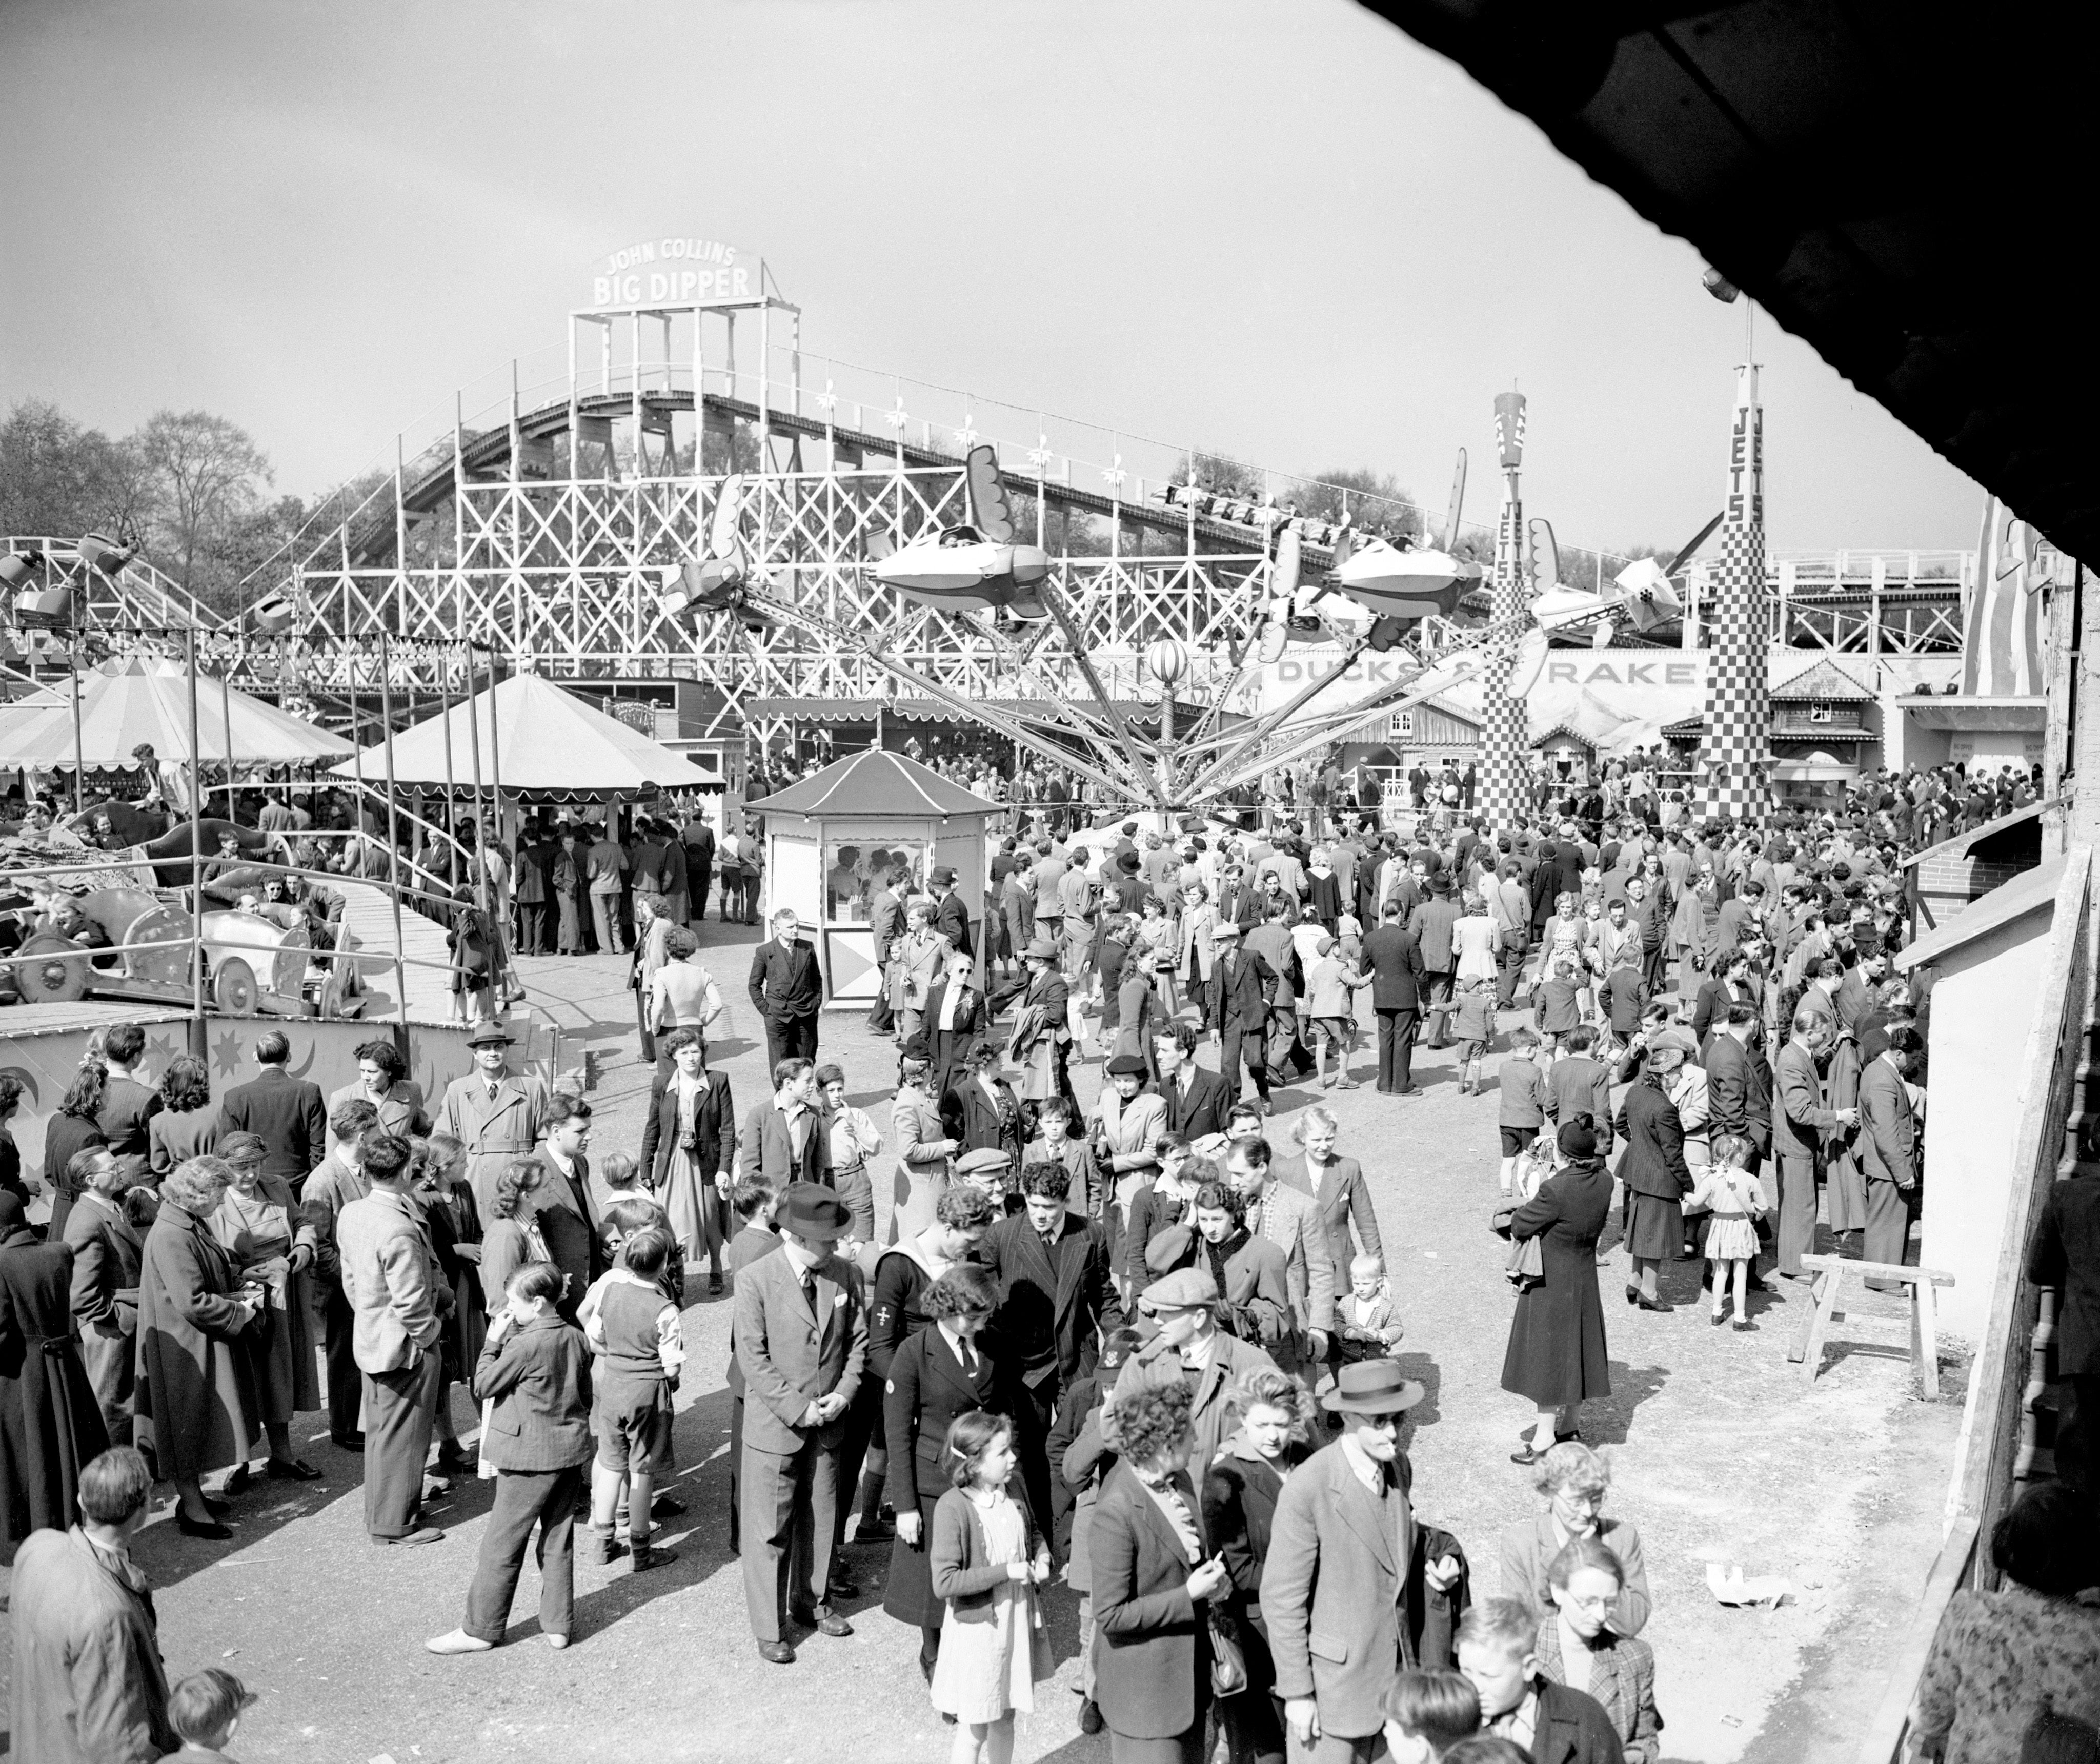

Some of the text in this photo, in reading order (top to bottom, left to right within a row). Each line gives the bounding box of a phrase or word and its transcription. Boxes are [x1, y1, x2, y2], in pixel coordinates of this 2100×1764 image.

[607, 238, 737, 276] JOHN COLLINS
[594, 268, 749, 306] BIG DIPPER
[1728, 407, 1749, 522] JETS
[1752, 408, 1764, 522] JETS
[1497, 502, 1513, 579] JETS
[1549, 662, 1708, 684] RAKE
